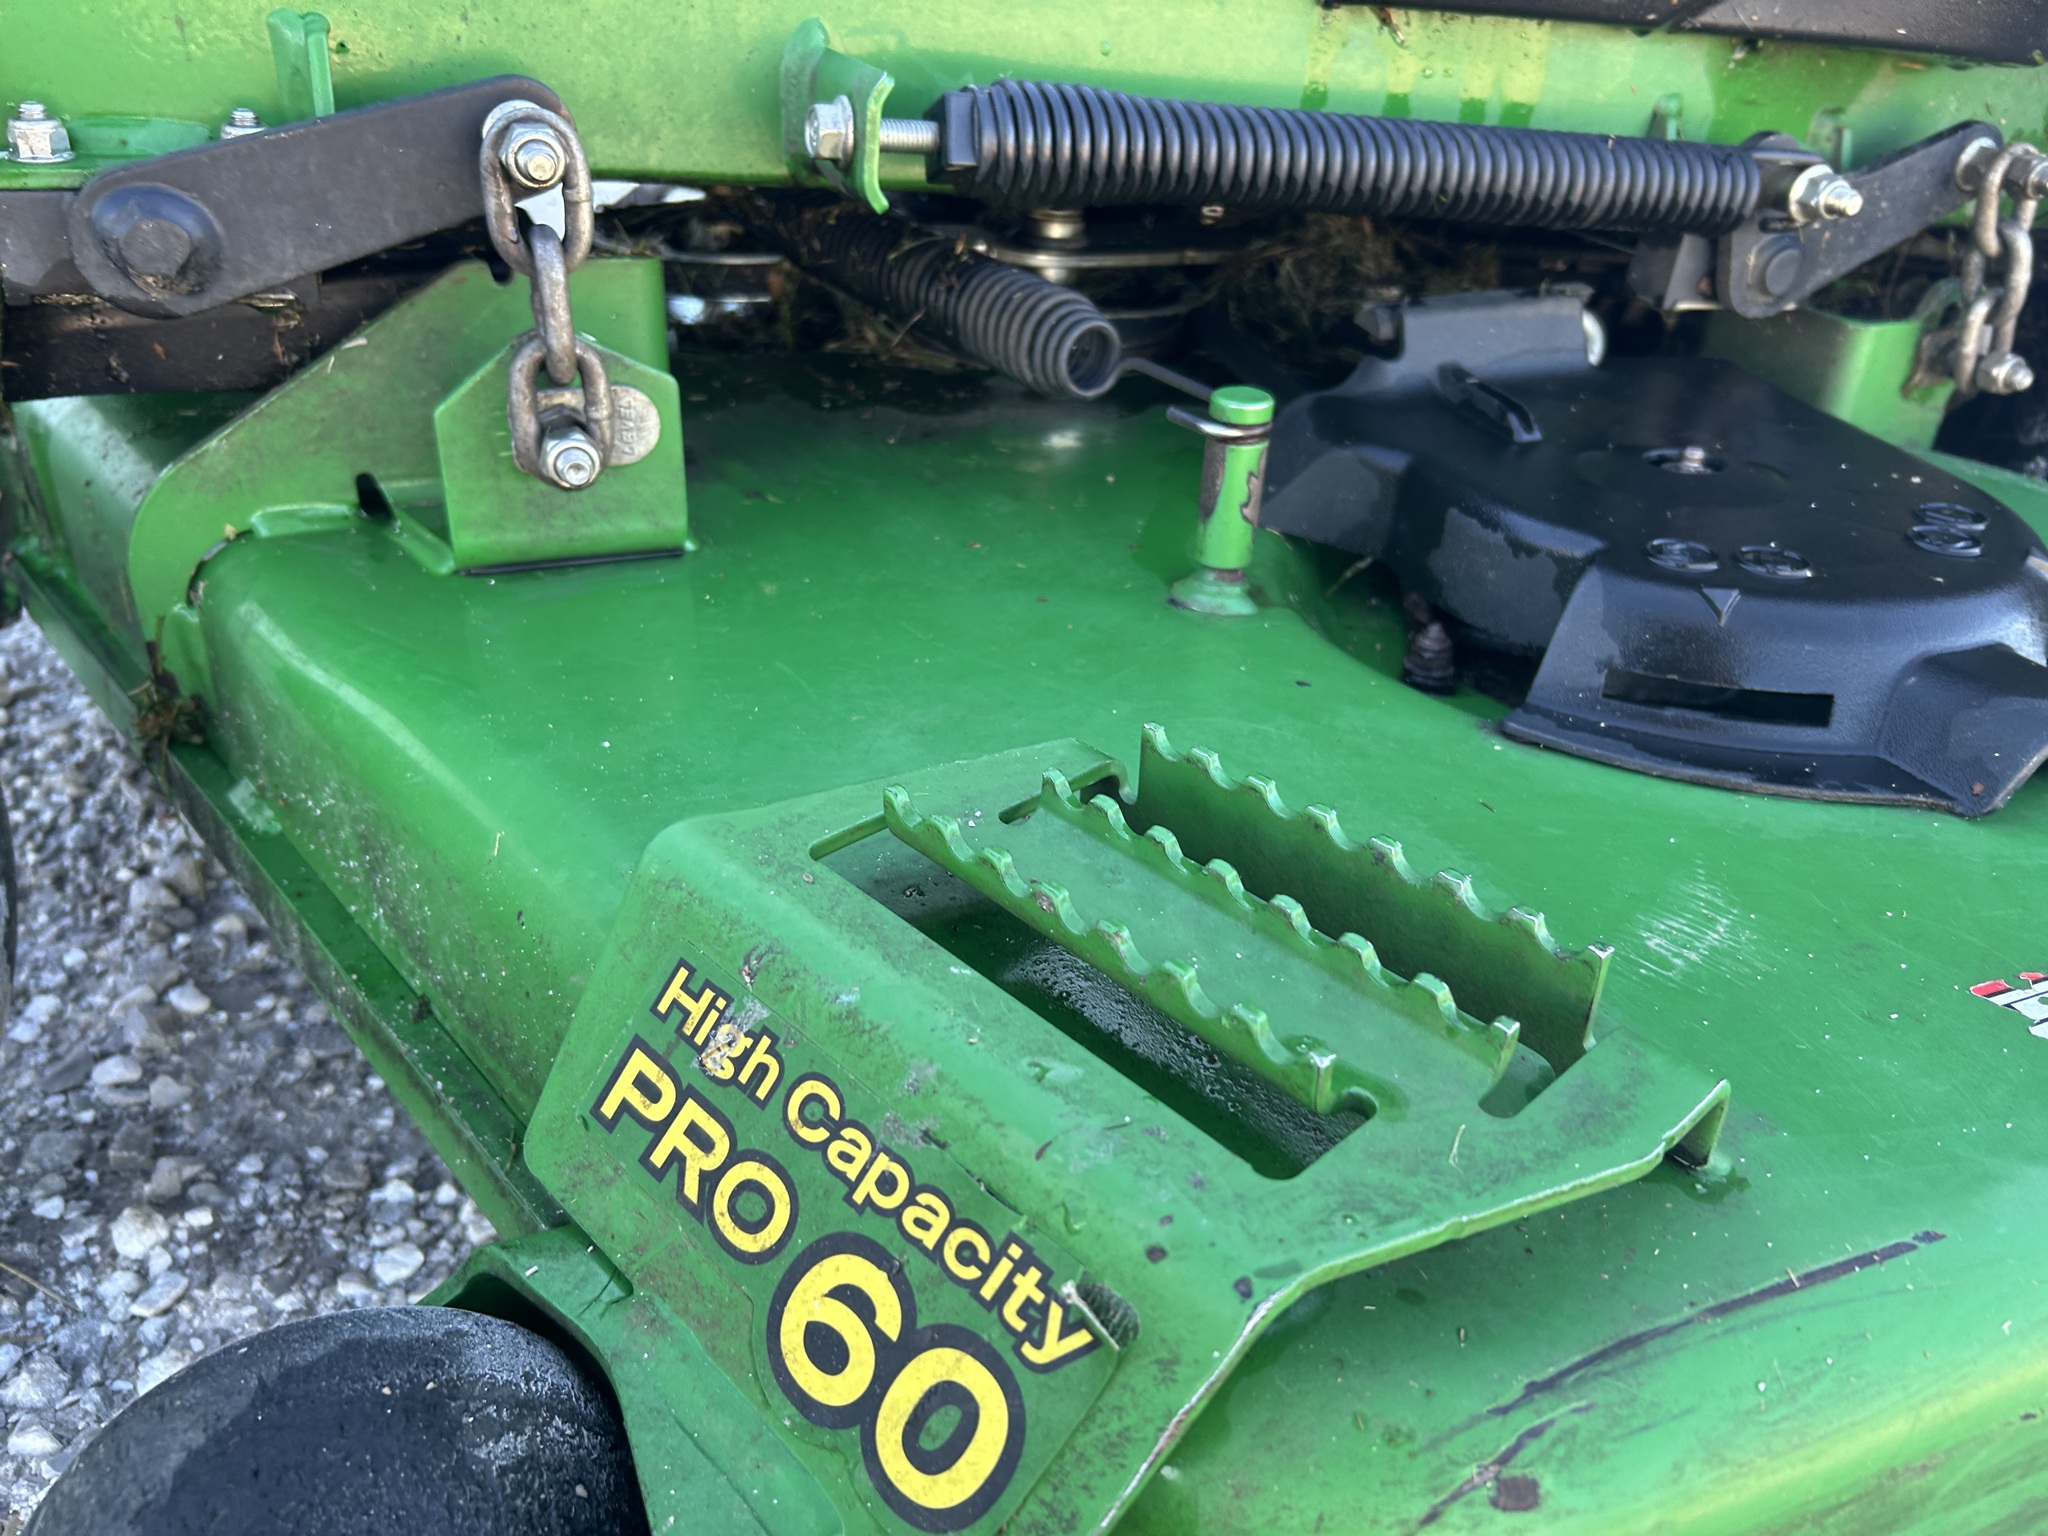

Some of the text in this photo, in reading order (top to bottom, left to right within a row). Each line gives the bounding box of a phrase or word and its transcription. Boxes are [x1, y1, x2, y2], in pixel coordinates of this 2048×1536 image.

[618, 400, 636, 457] LEVEL
[599, 1046, 1014, 1516] PRO 60
[654, 963, 1096, 1368] High Capacity
